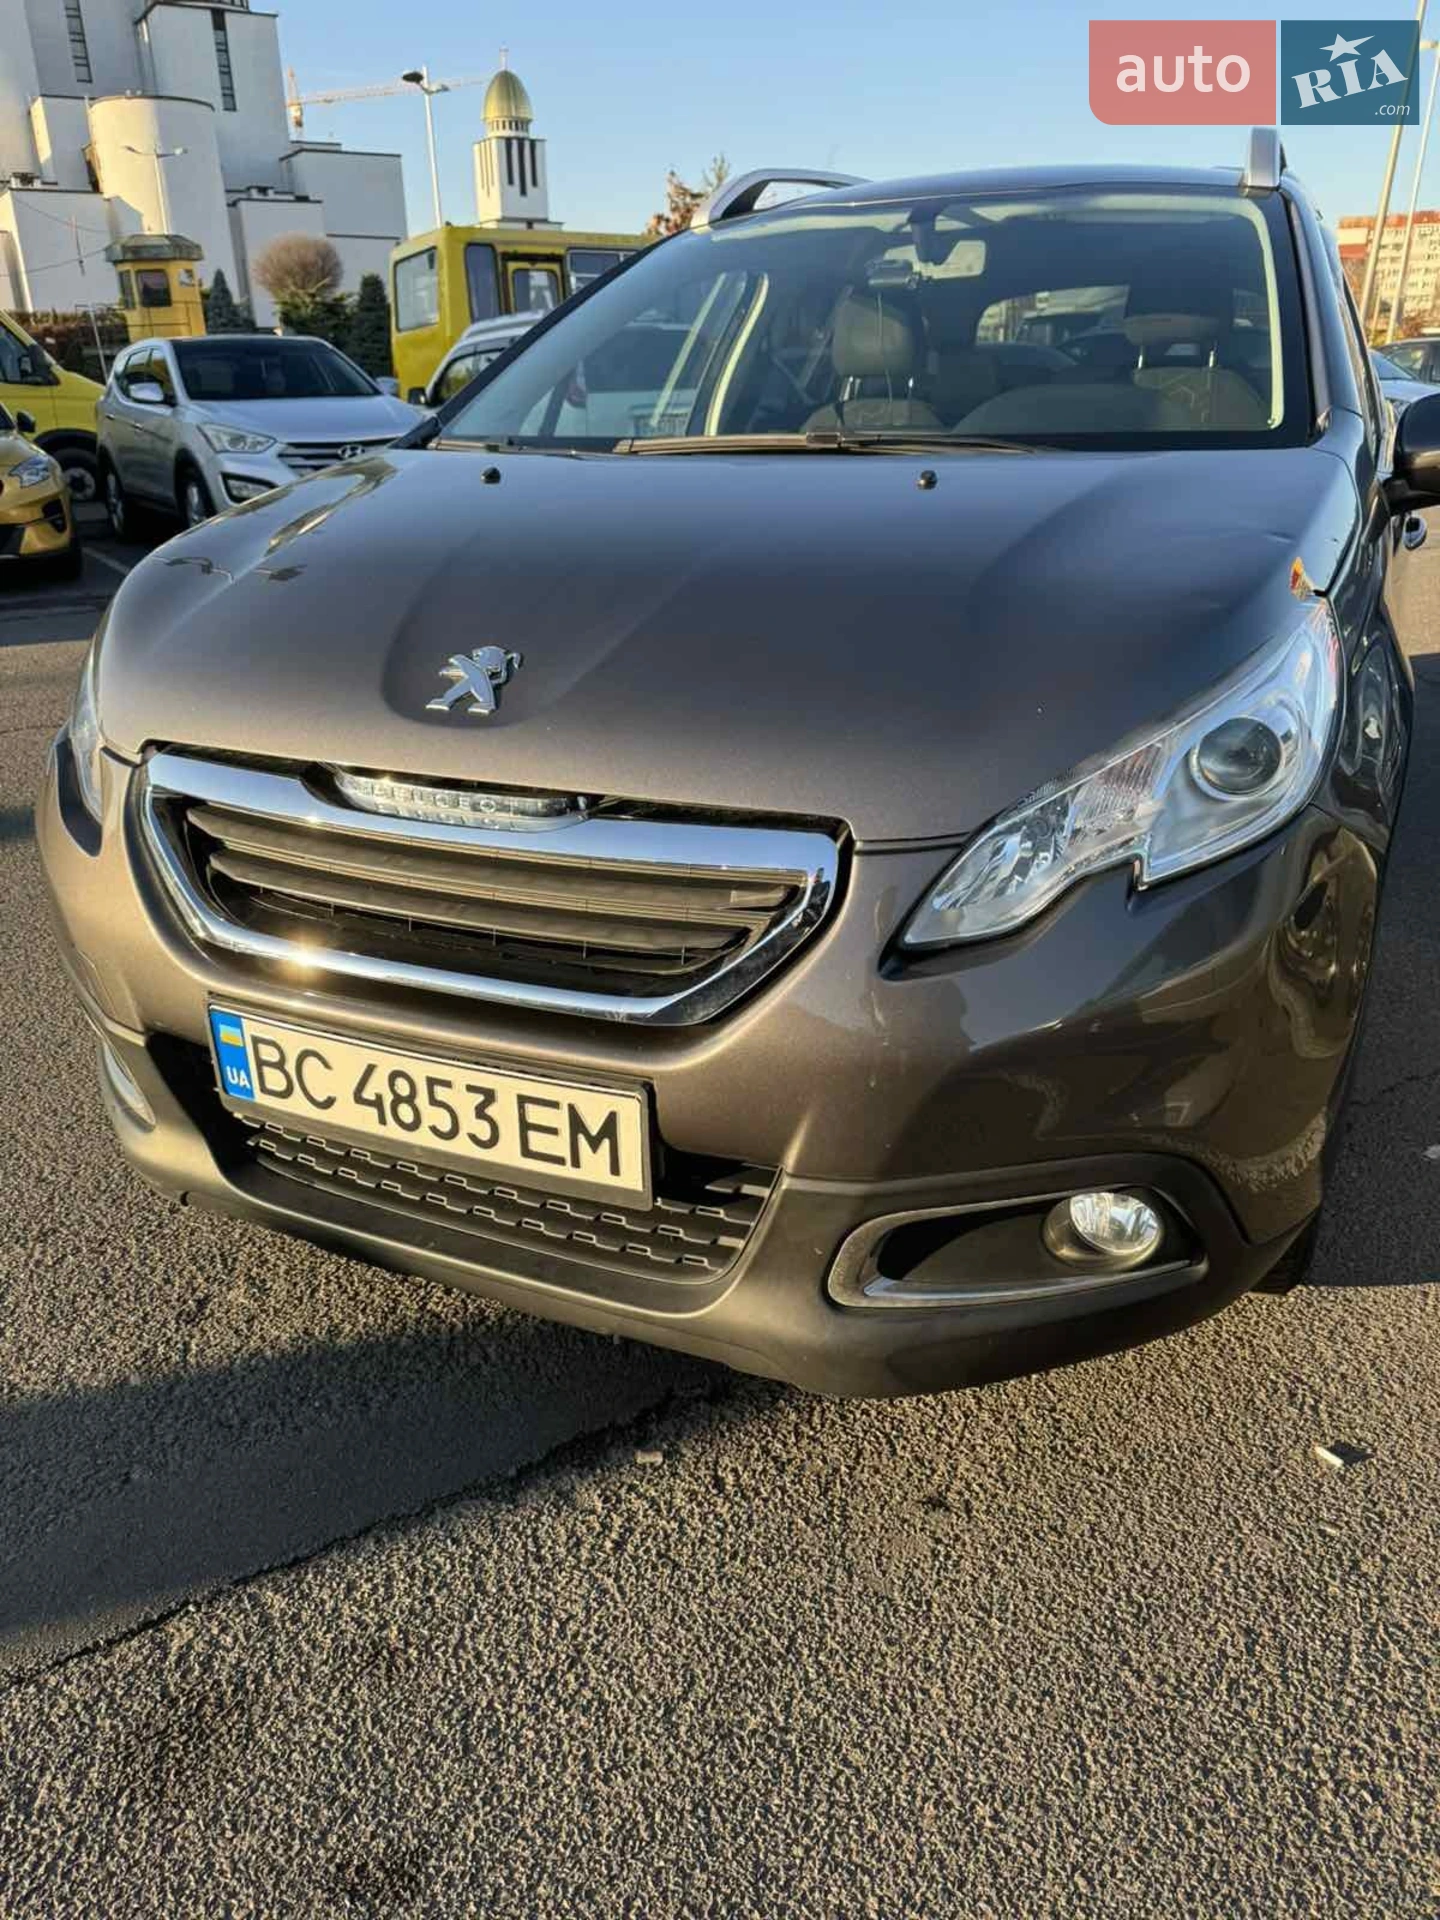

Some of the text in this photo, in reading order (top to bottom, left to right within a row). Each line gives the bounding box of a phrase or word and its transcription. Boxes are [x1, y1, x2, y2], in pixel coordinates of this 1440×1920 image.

[226, 1065, 251, 1090] UA
[250, 1034, 622, 1177] BC 4853 EM
